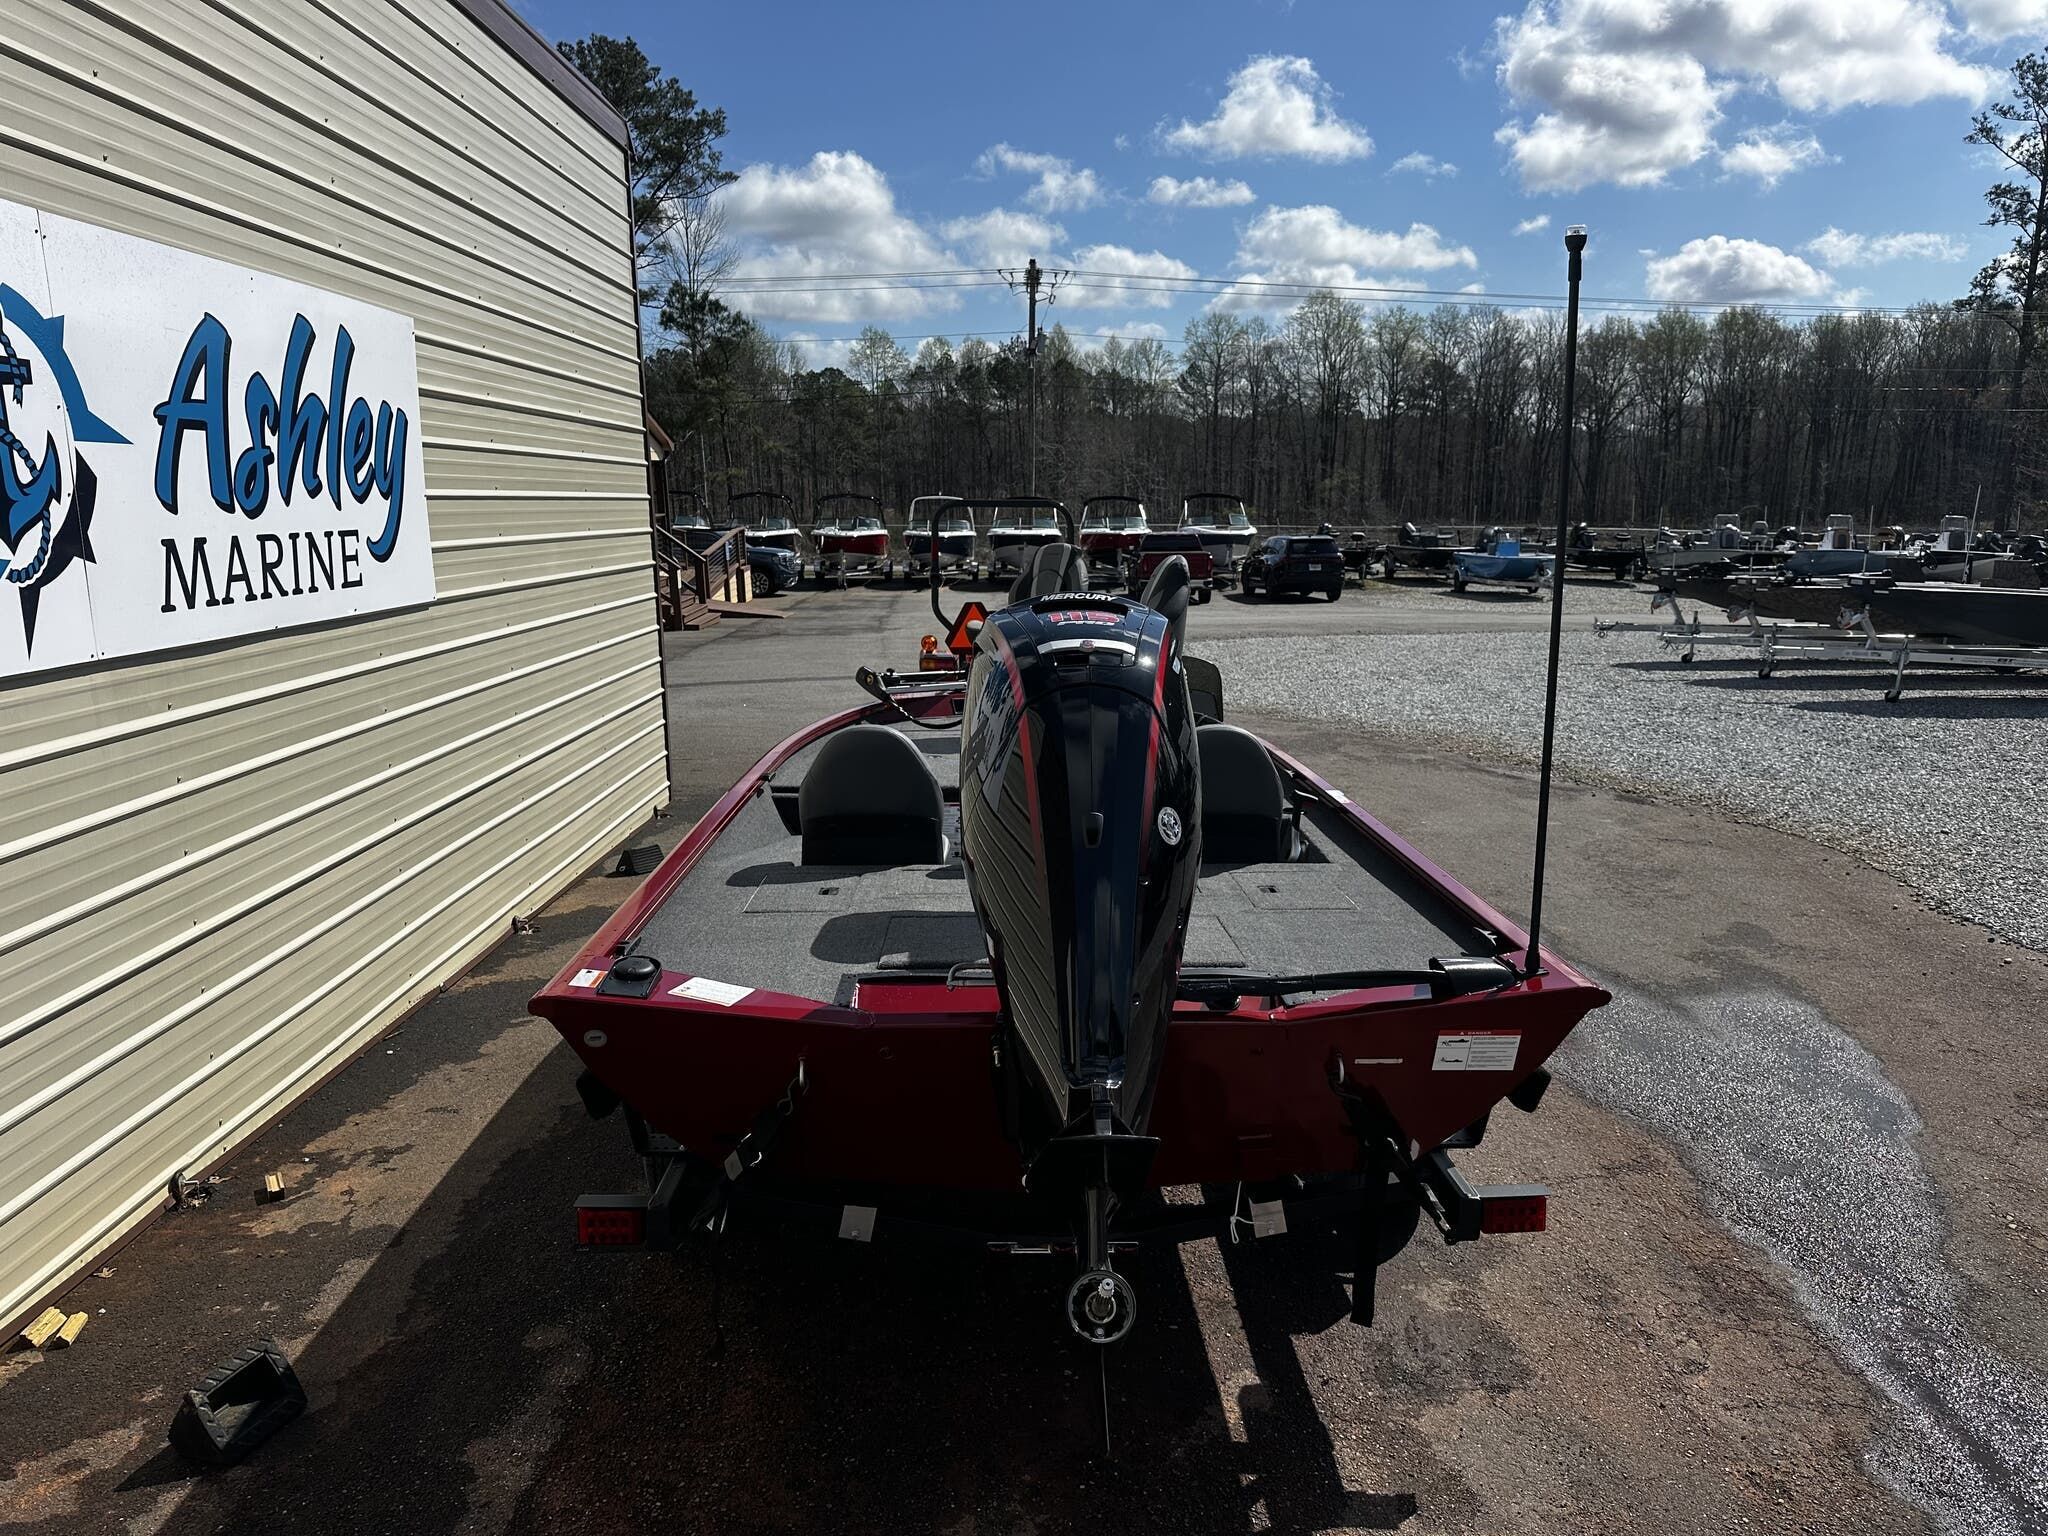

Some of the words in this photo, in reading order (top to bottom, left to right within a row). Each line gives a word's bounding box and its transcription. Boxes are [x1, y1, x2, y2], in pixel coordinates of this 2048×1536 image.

[153, 312, 408, 563] Ashley
[160, 530, 363, 613] MARINE
[1041, 592, 1117, 602] MERCURY
[1049, 611, 1119, 622] 115
